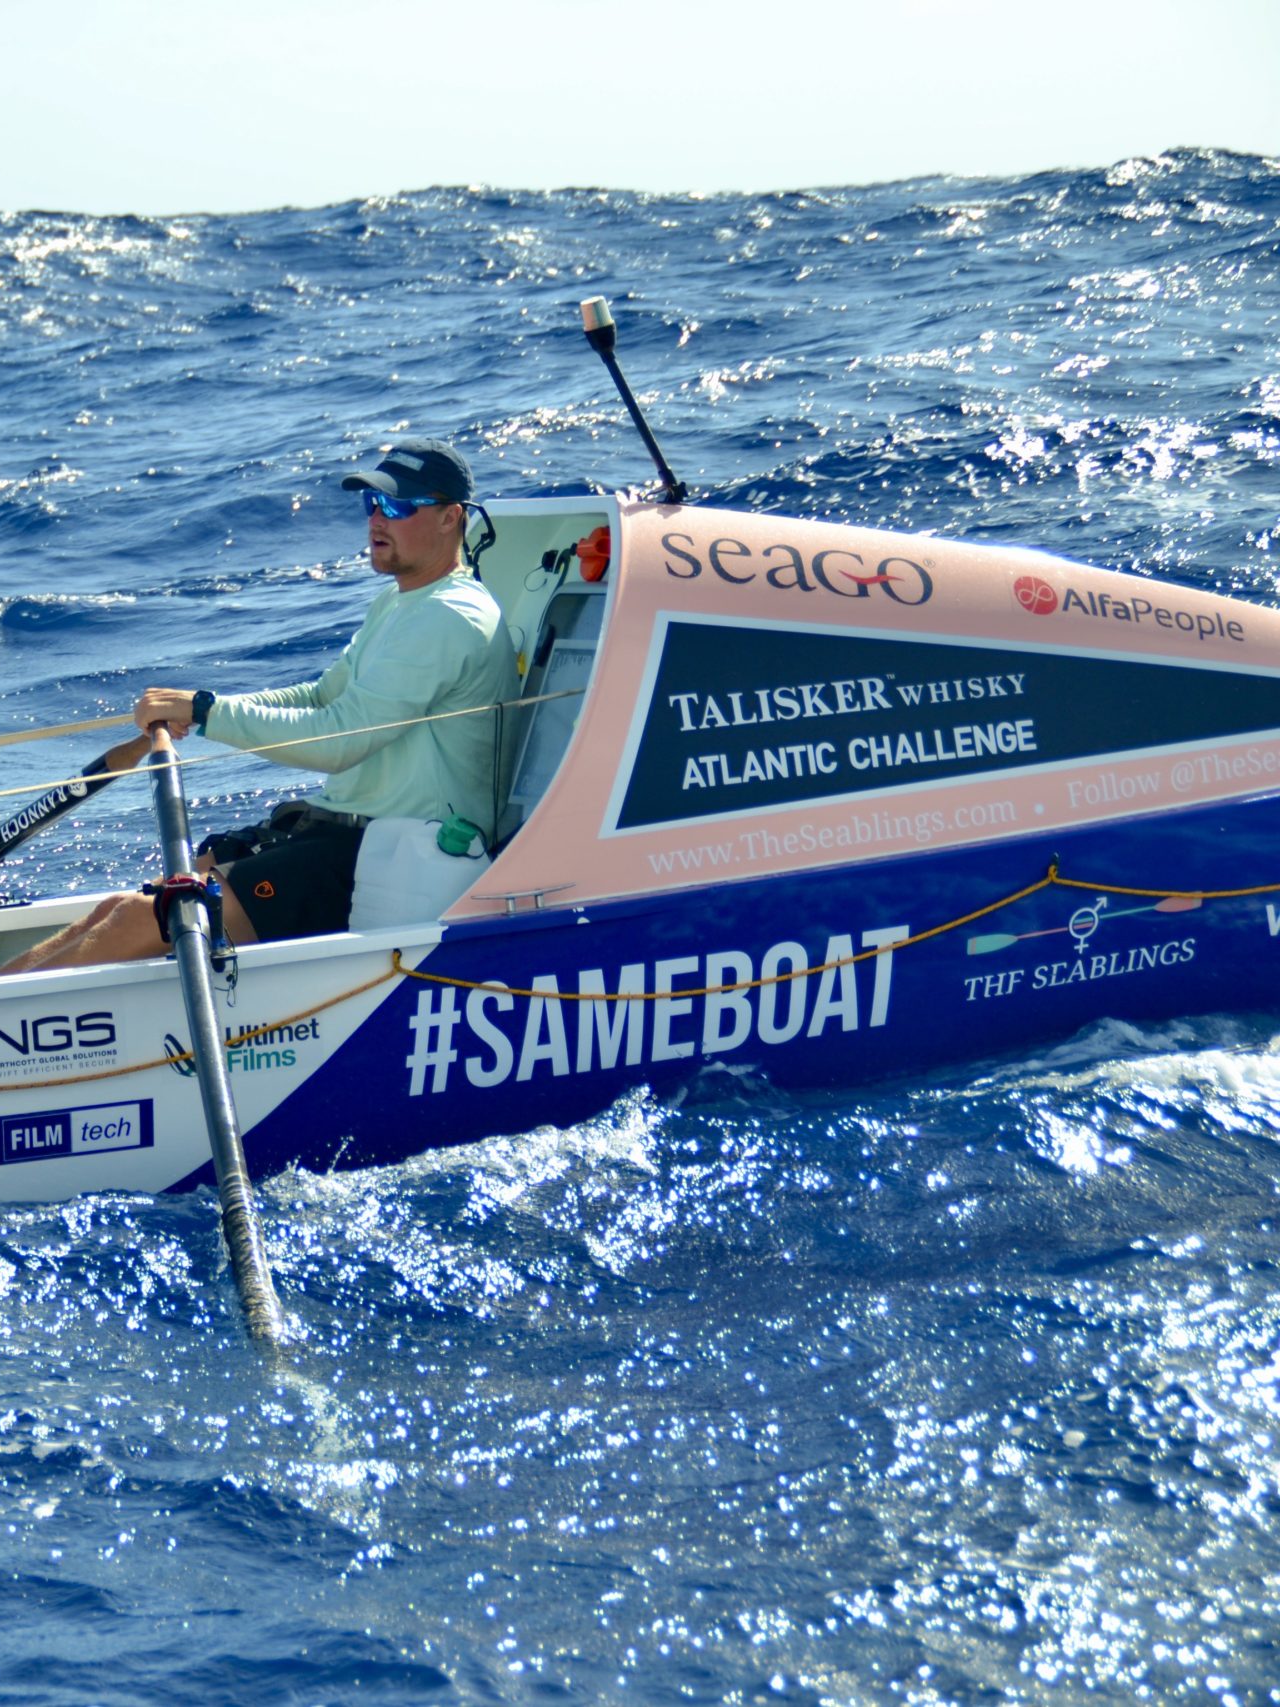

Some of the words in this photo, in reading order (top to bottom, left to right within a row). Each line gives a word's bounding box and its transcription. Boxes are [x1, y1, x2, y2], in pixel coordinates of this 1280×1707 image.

[1062, 588, 1244, 642] AlfaPeople
[669, 677, 892, 731] TALISKER
[896, 673, 1025, 706] WHISKY
[682, 742, 837, 790] ATLANTIC
[848, 719, 1037, 770] CHALLENGE
[1067, 771, 1161, 808] Follow
[1171, 748, 1280, 792] @TheSe
[1, 786, 68, 842] RANNOCH
[648, 800, 1017, 874] www.TheSeablings.com
[1032, 938, 1196, 989] SEABLINGS
[225, 1018, 320, 1049] Ultimet
[406, 925, 910, 1096] #SAMEBOAT
[23, 1064, 73, 1075] EFFICIENT
[79, 1058, 117, 1069] SECURE
[39, 1055, 70, 1064] GLOBAL
[73, 1049, 117, 1060] SOLUTIONS
[227, 1048, 297, 1073] Films
[11, 1124, 63, 1150] FILM
[81, 1117, 131, 1141] tech
